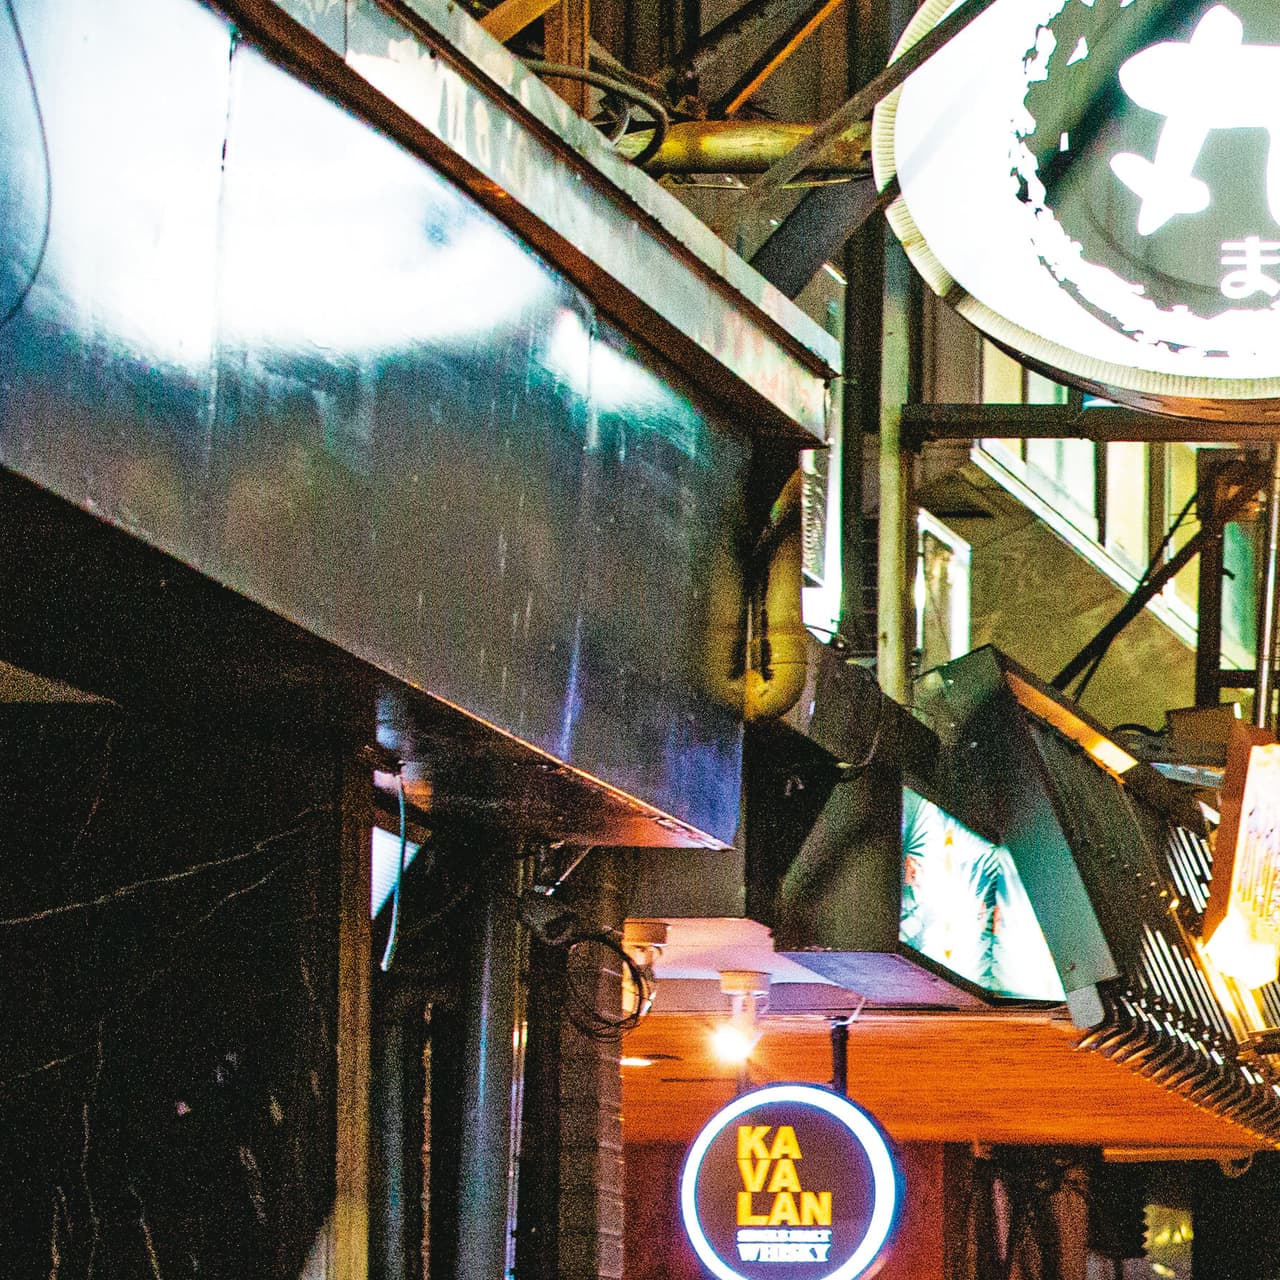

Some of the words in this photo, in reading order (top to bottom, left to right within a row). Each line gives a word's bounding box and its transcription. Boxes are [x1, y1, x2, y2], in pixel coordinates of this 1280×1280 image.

[736, 1125, 803, 1159] KA
[736, 1158, 802, 1193] VA
[736, 1191, 833, 1226] LAN
